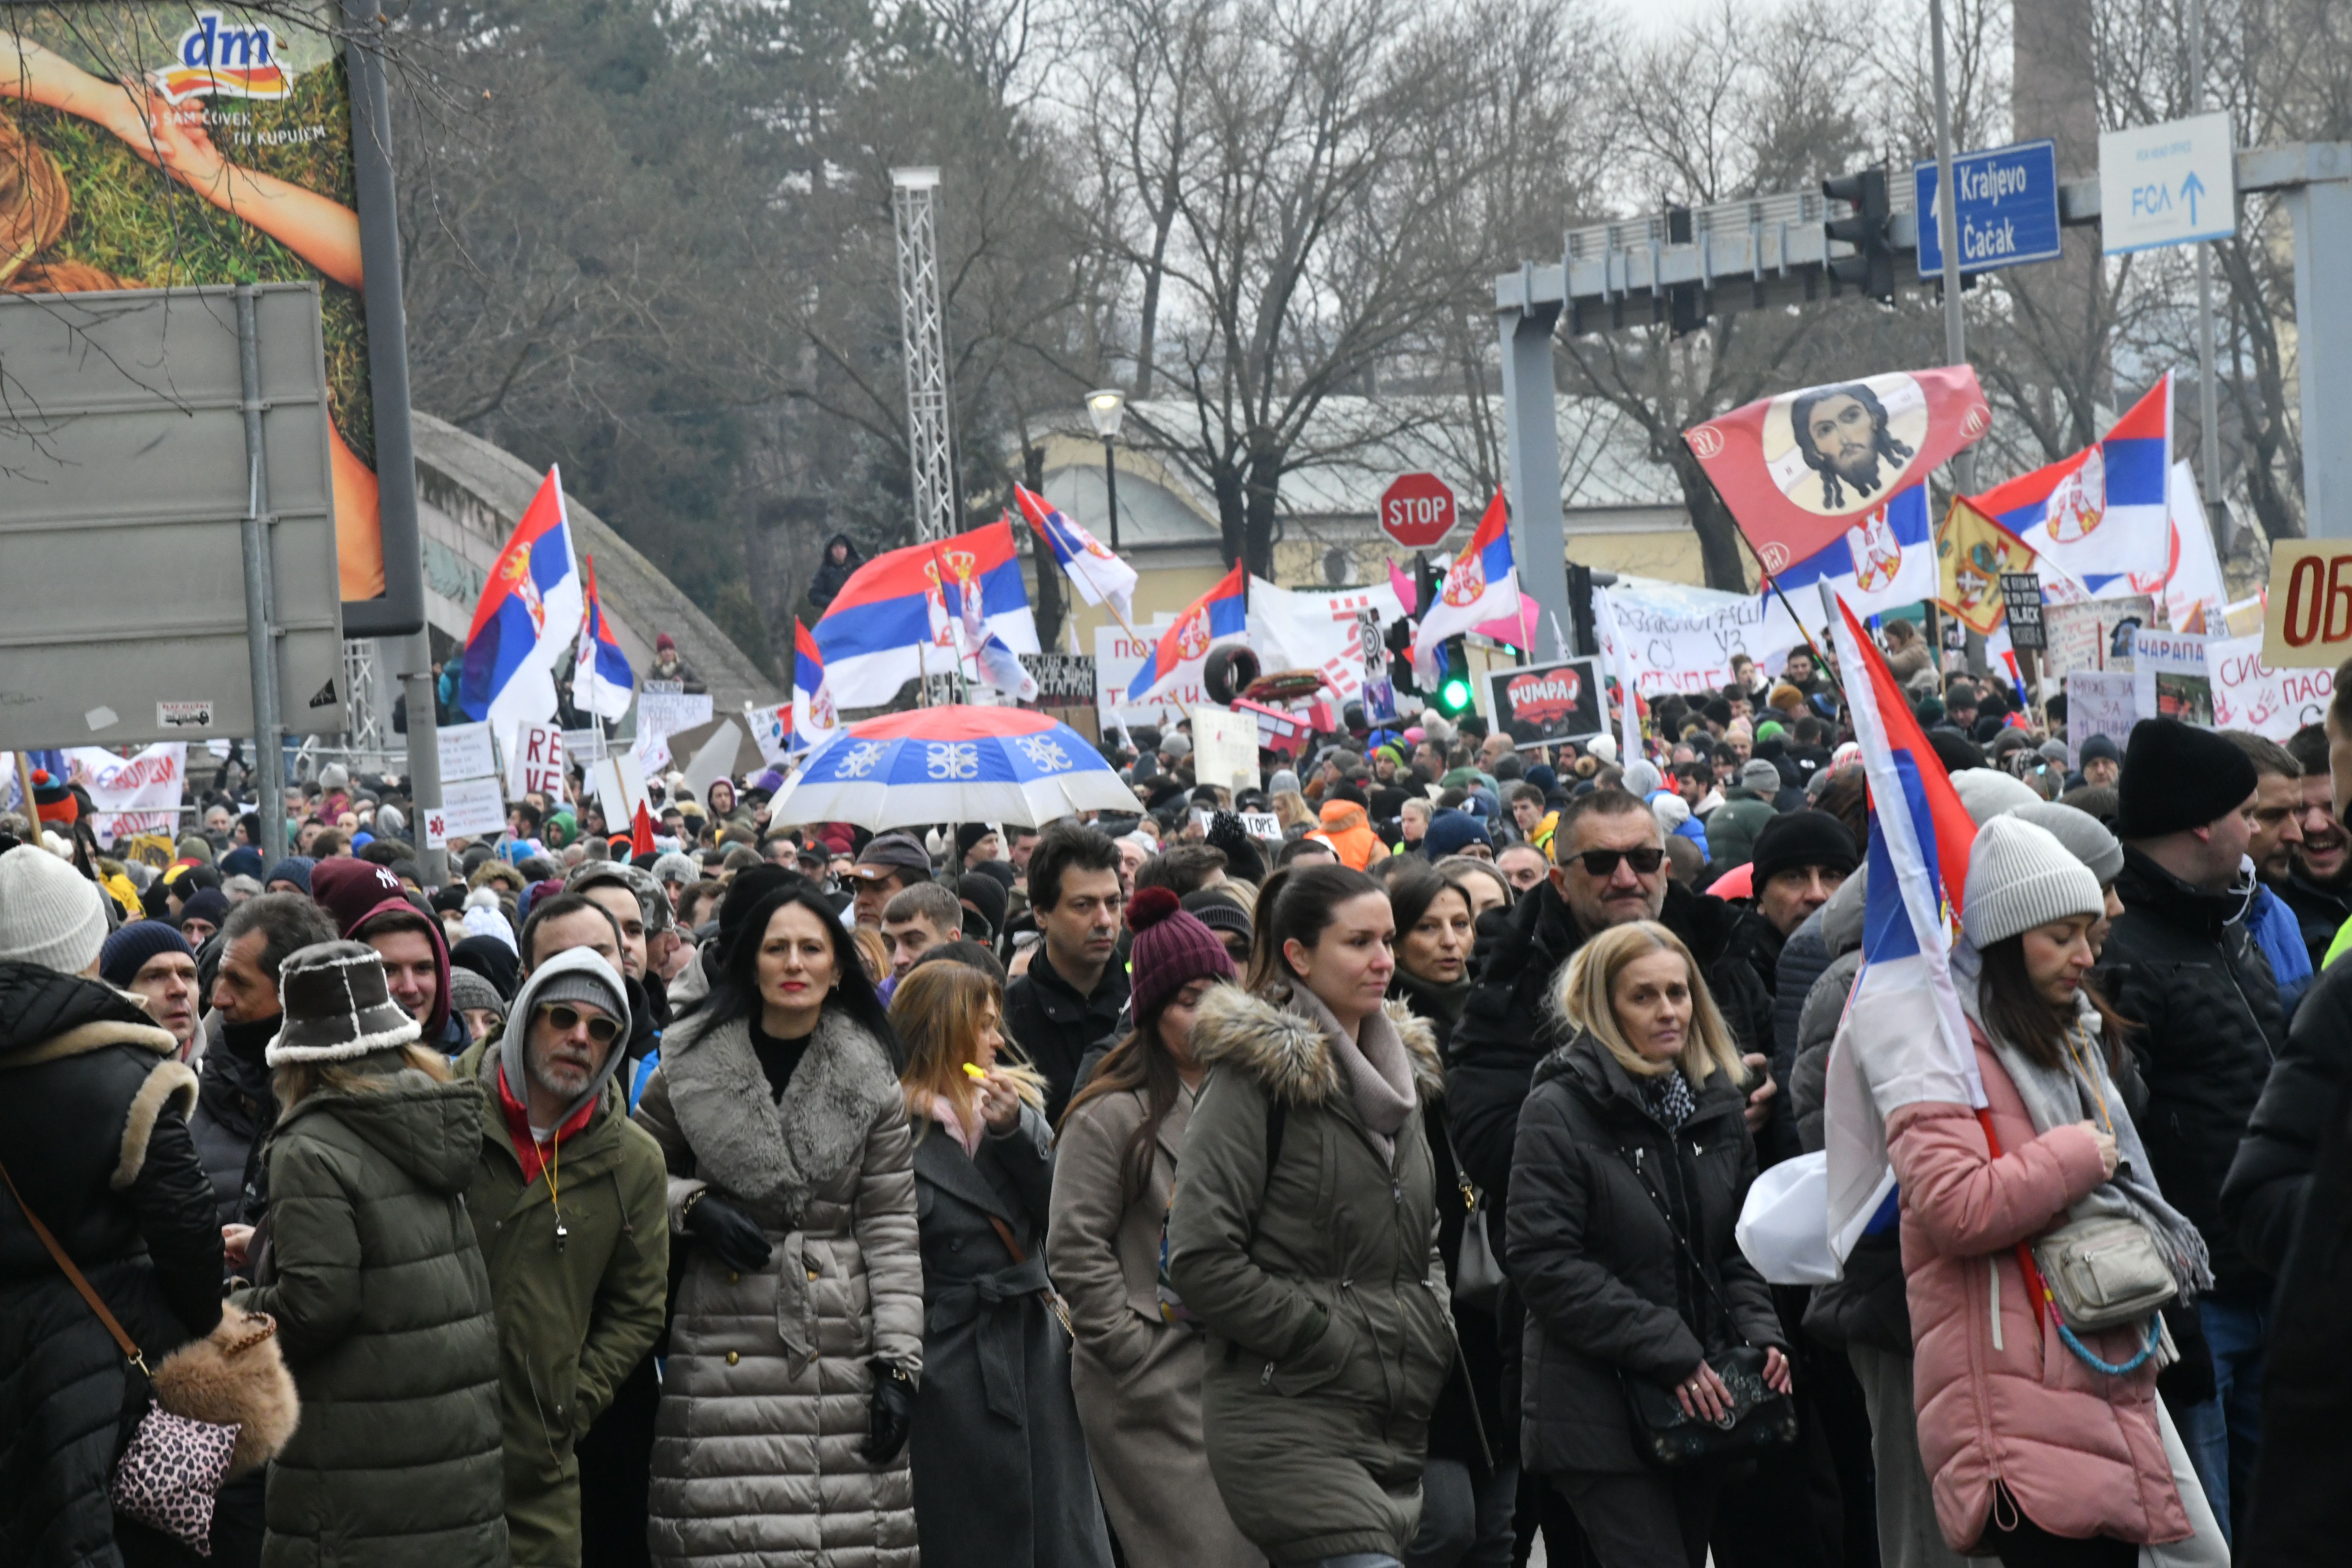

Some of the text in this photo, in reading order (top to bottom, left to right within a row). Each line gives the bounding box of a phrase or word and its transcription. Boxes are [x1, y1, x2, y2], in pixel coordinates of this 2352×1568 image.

[183, 16, 269, 66] dm
[164, 111, 196, 126] SAM
[257, 124, 326, 146] KUPUJEM
[1960, 161, 2026, 207] Kraljevo
[1965, 214, 2015, 259] Čačak
[1389, 496, 1446, 526] STOP
[1648, 639, 1675, 669] СУ
[2139, 639, 2204, 662] ЧАРАПА
[1509, 679, 1578, 709] PUMPAJ
[2283, 670, 2332, 705] ПАО
[1249, 817, 1276, 835] ГОРЕ
